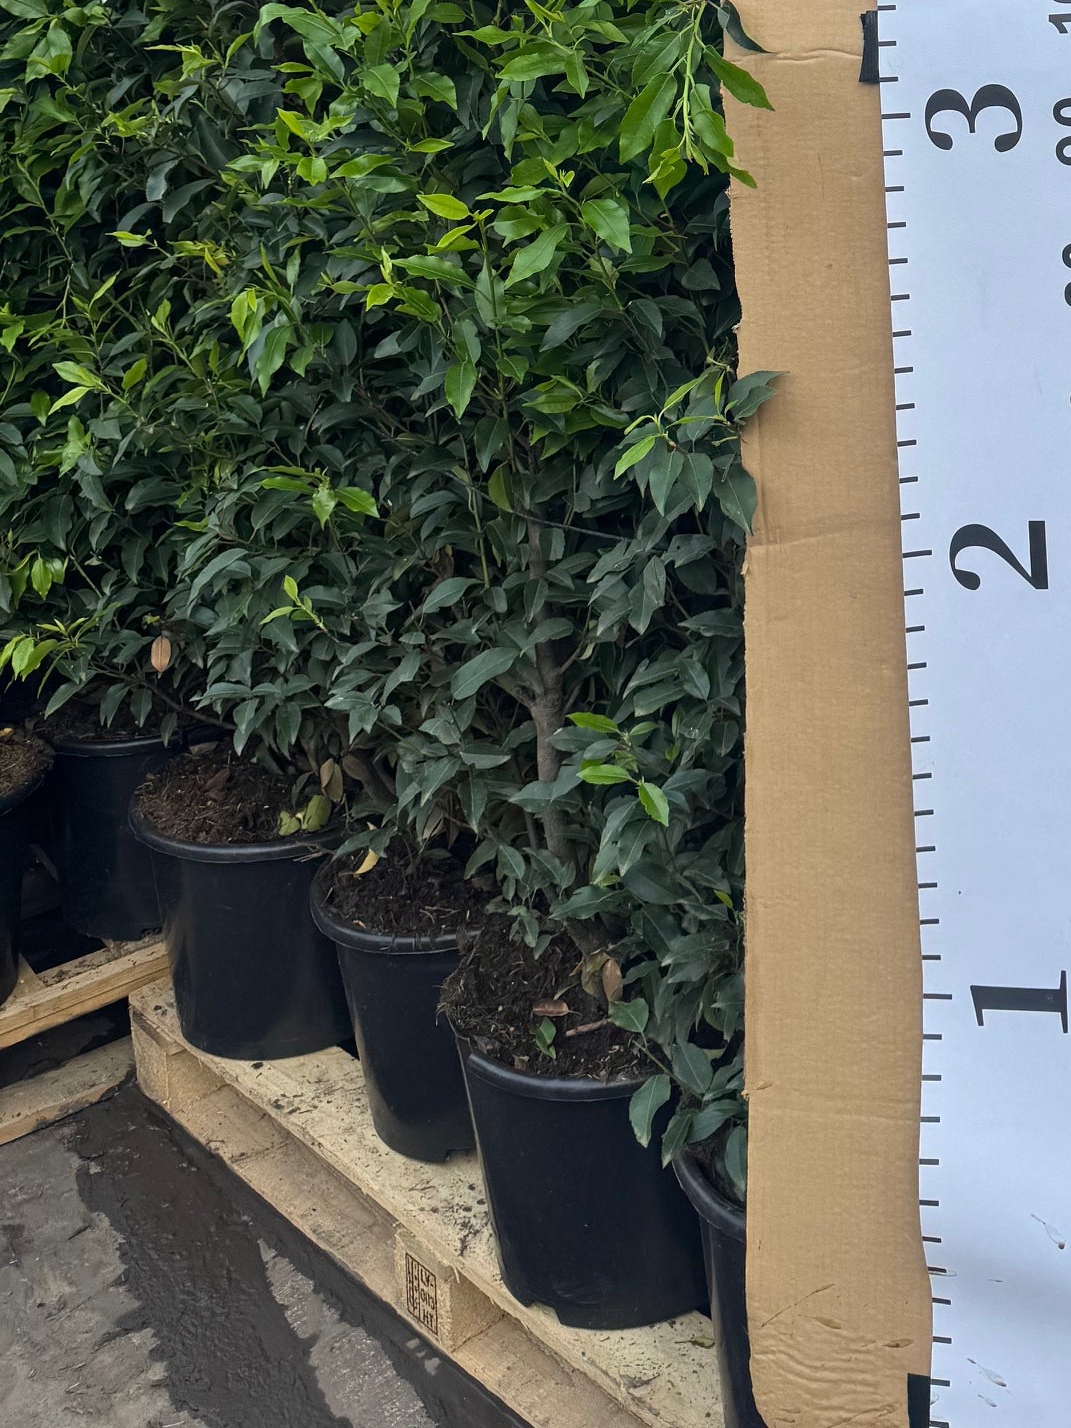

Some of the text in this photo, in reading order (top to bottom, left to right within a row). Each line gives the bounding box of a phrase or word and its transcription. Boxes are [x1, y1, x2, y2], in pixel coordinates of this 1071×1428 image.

[925, 84, 1022, 152] 3
[950, 521, 1048, 590] 2
[970, 971, 1068, 1033] 1
[422, 1308, 434, 1329] HT
